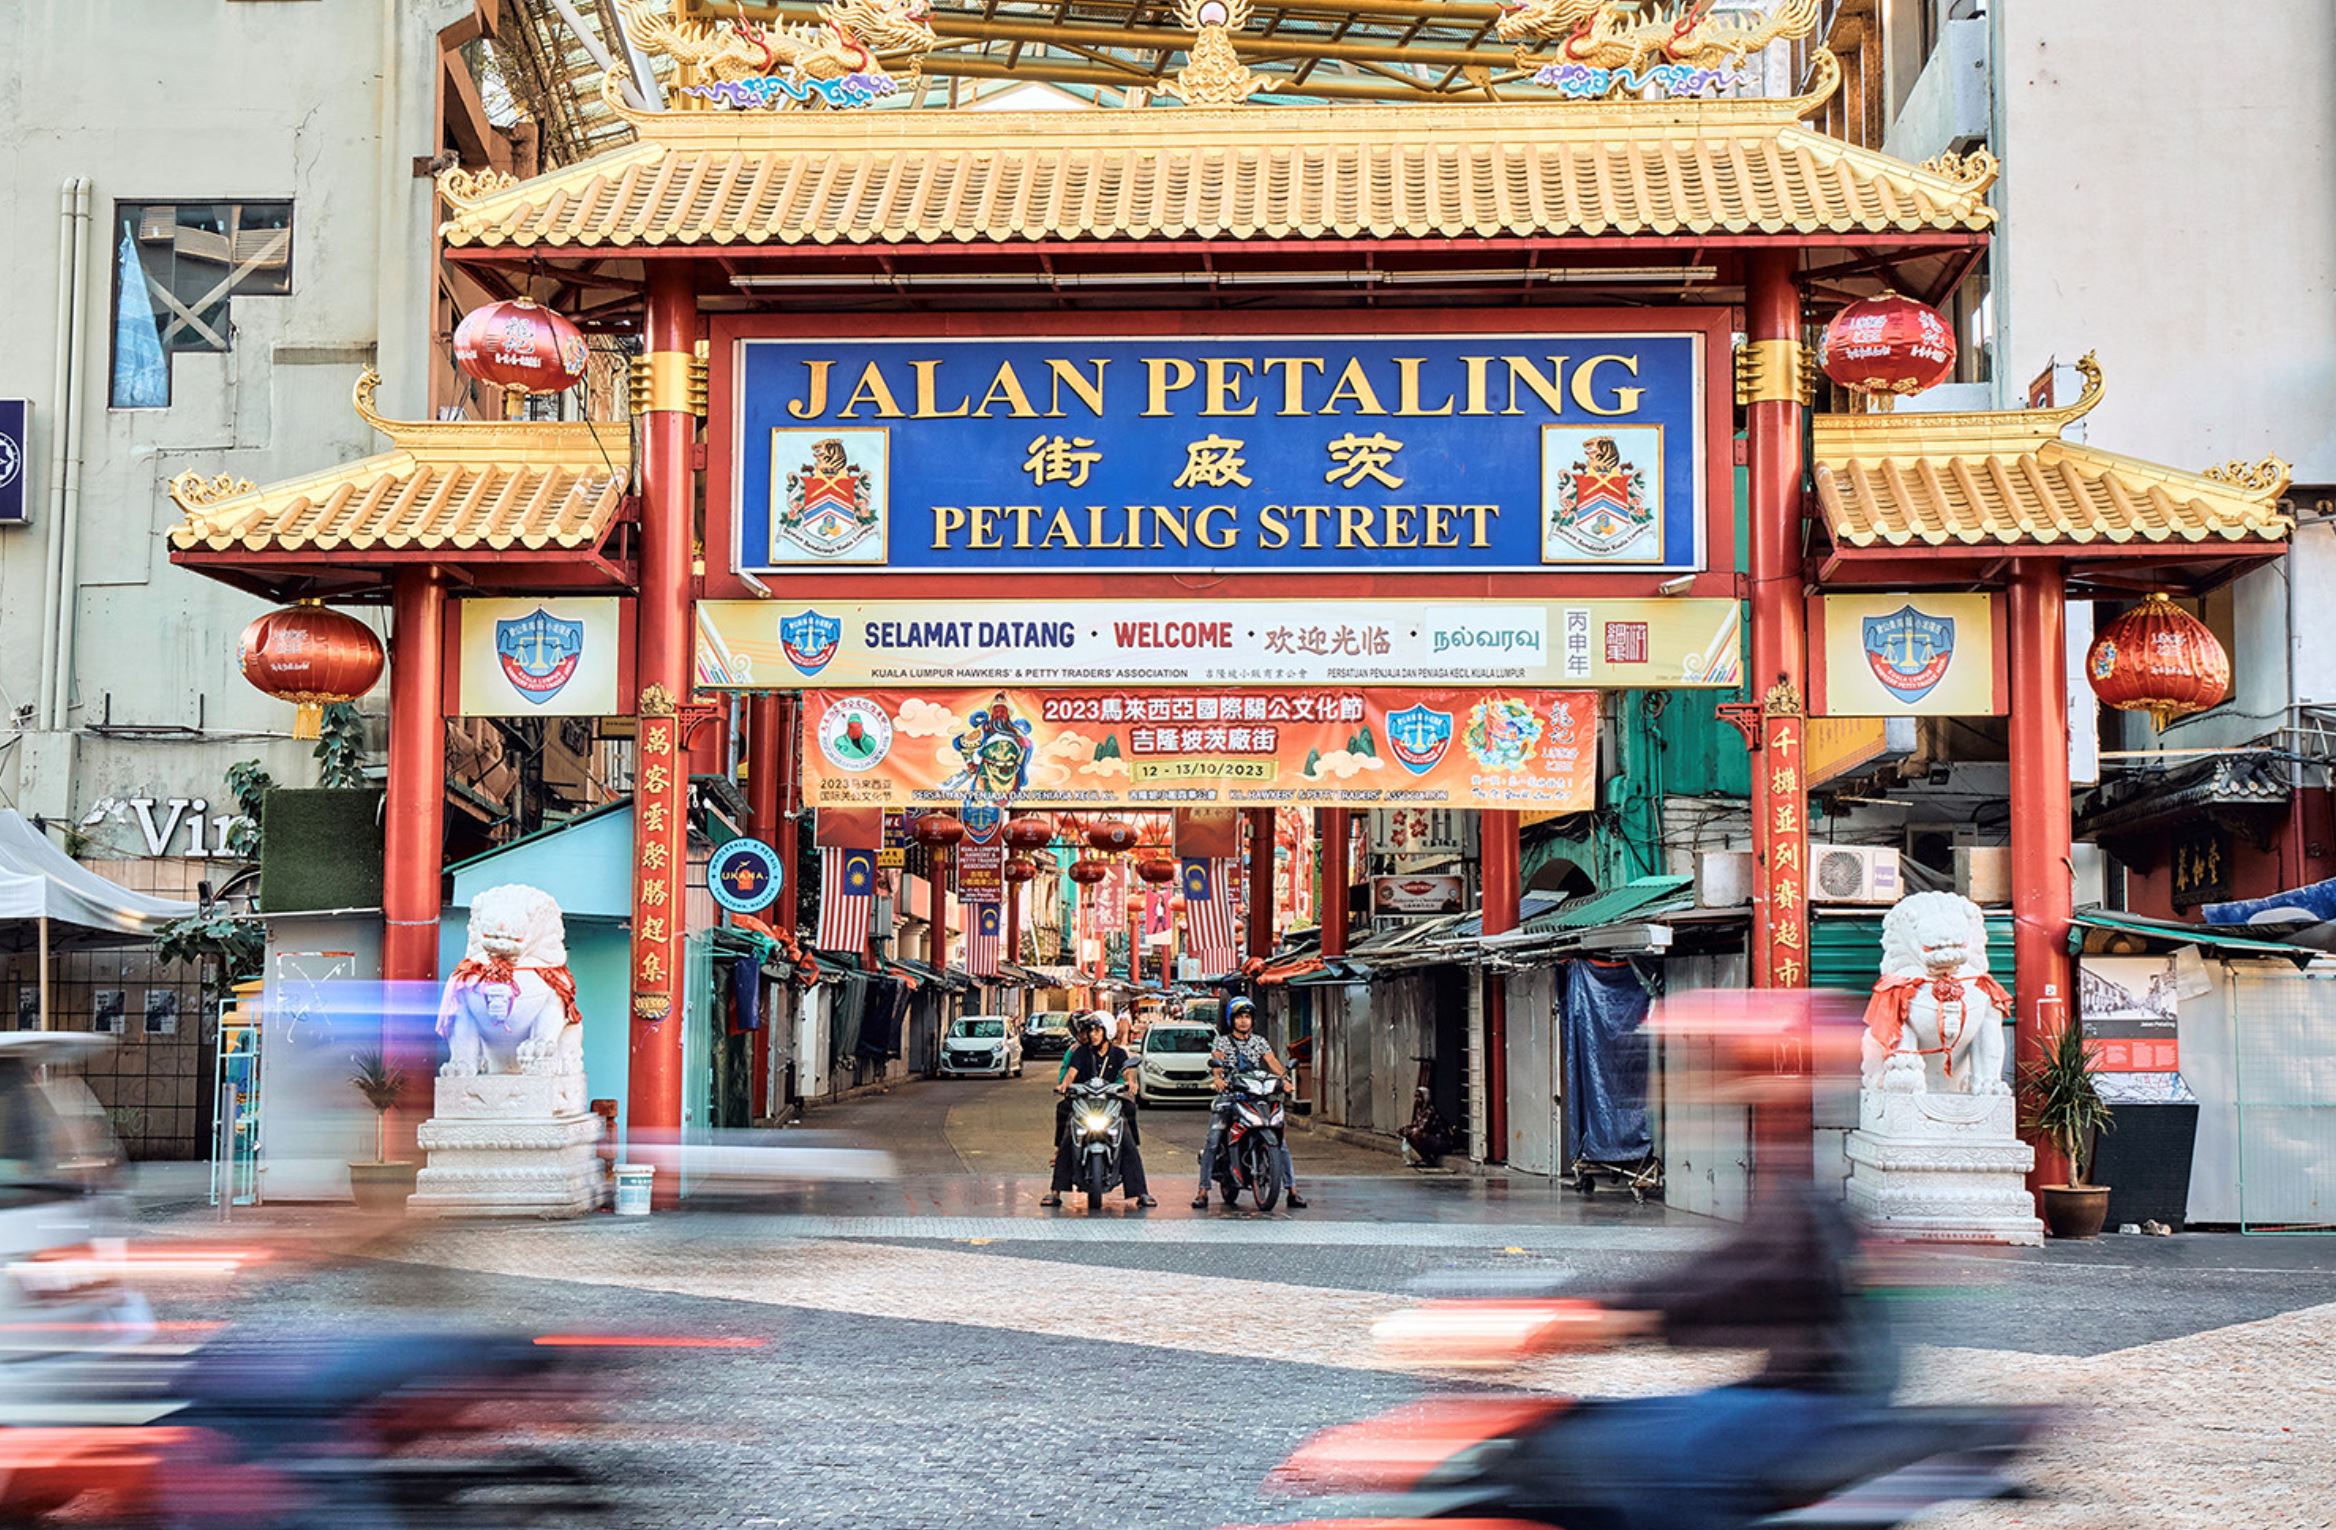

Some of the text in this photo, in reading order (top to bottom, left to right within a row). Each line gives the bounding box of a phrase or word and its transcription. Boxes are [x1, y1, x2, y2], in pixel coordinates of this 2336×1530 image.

[787, 354, 1646, 419] JALAN PETALING
[929, 504, 1499, 551] PETALING STREET
[864, 621, 973, 649] SELAMAT
[978, 621, 1075, 649] DATANG
[1113, 621, 1233, 649] WELCOME
[1264, 624, 1392, 656] 欢迎光临
[1433, 626, 1540, 653] நல்வரவு
[1567, 611, 1589, 676] 丙申年
[871, 668, 908, 679] KUALA
[909, 668, 954, 679] LUMPUR
[1015, 668, 1022, 678] &
[1025, 668, 1059, 679] PETTY
[1116, 668, 1189, 679] ASSOCIATION
[1327, 667, 1369, 679] PERSATUAN
[1471, 667, 1496, 679] KUALA
[1497, 667, 1526, 679] LUMPUR
[1045, 697, 1363, 721] 2023馬來西亞國際關公文化節
[1132, 728, 1276, 752] 吉隆坡茨廠街
[1143, 765, 1158, 777] 12
[1176, 762, 1264, 778] 13/10/2023
[820, 791, 892, 801] 国际关公文化节
[912, 790, 968, 801] PERSATUAN
[969, 790, 1008, 801] PENJAJA
[1009, 790, 1029, 800] DAN
[1031, 790, 1073, 800] PENIAGA
[1306, 790, 1334, 800] PETTY
[1384, 790, 1449, 801] ASSOCIATION
